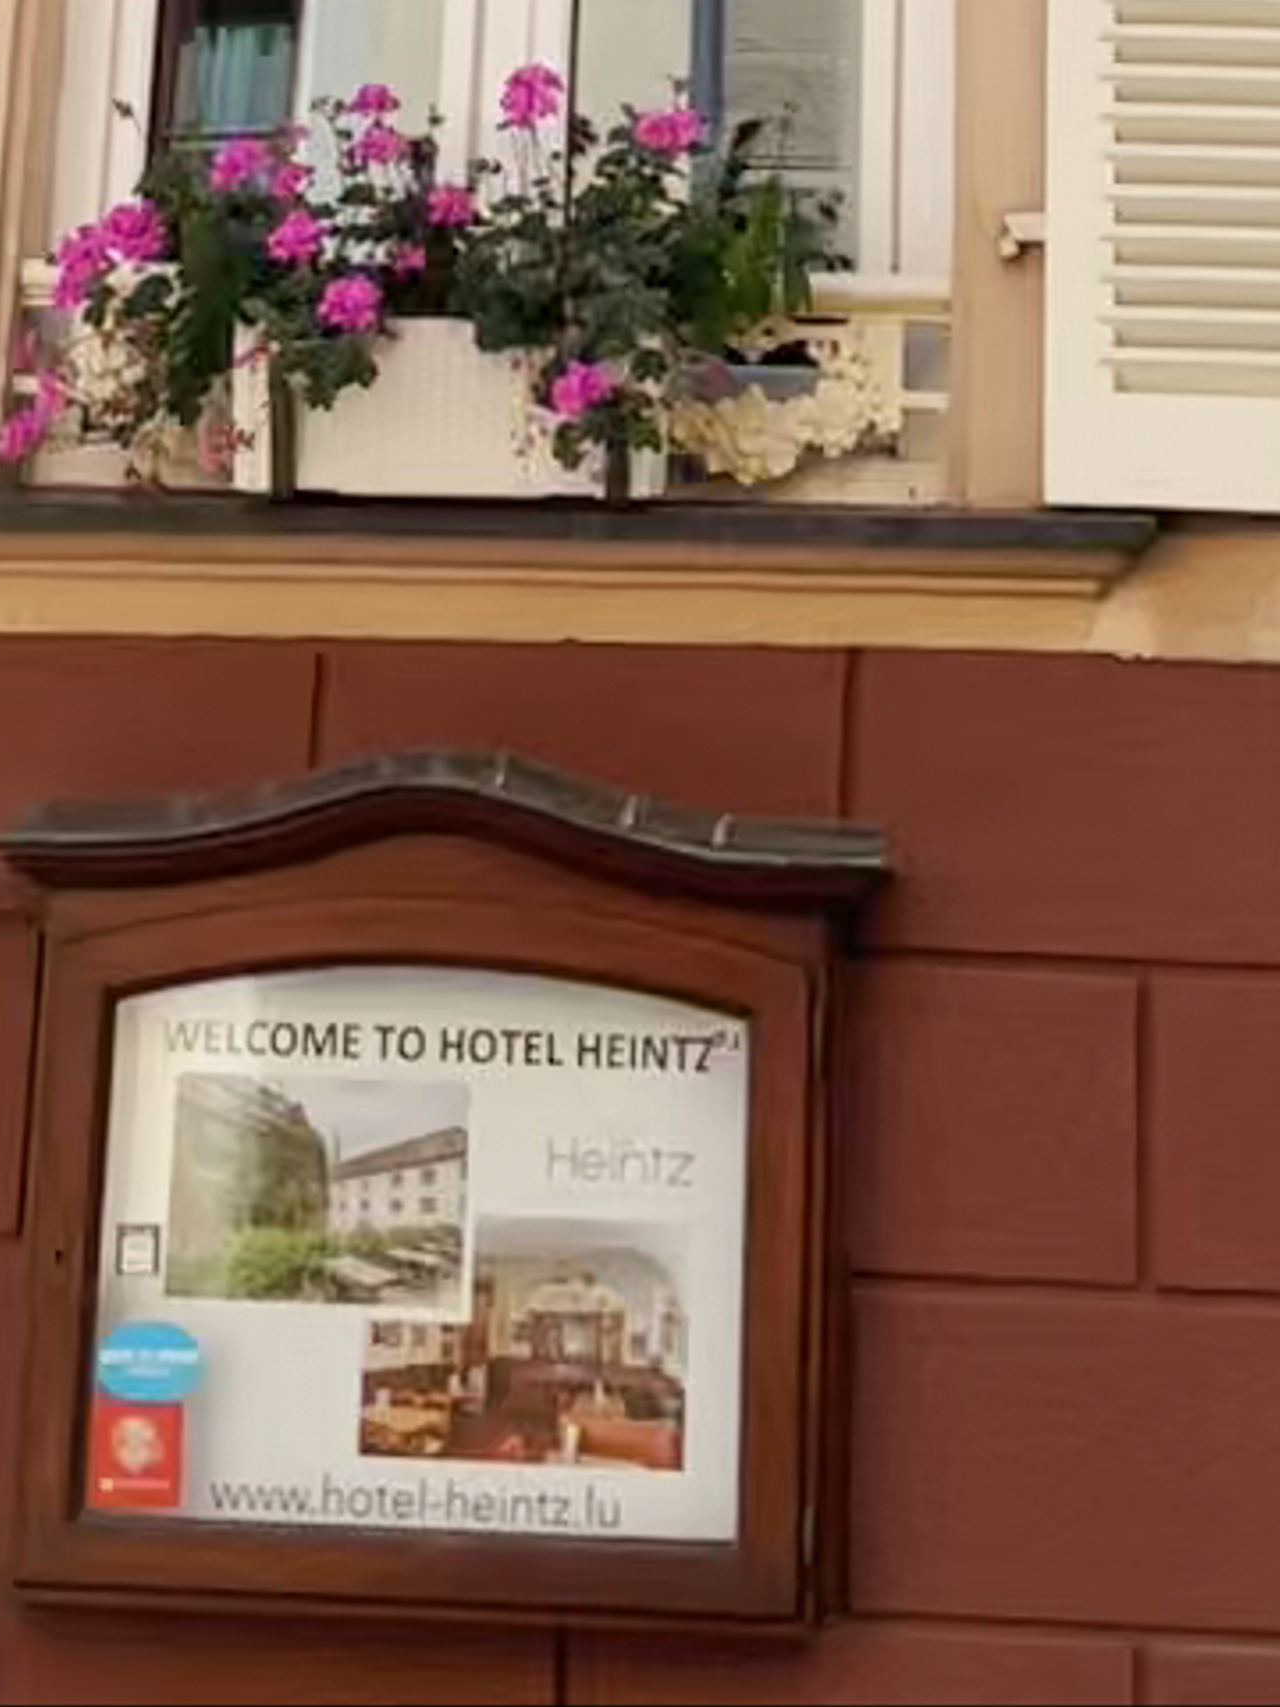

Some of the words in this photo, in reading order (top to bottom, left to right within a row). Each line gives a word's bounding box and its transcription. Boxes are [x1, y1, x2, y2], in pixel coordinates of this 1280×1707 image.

[163, 1019, 360, 1059] WELCOME
[373, 1025, 427, 1062] TO
[439, 1027, 563, 1067] HOTEL
[576, 1032, 712, 1073] HEINTZ
[546, 1136, 696, 1188] Heintz
[209, 1476, 623, 1529] www.hotel-heintz.lu
